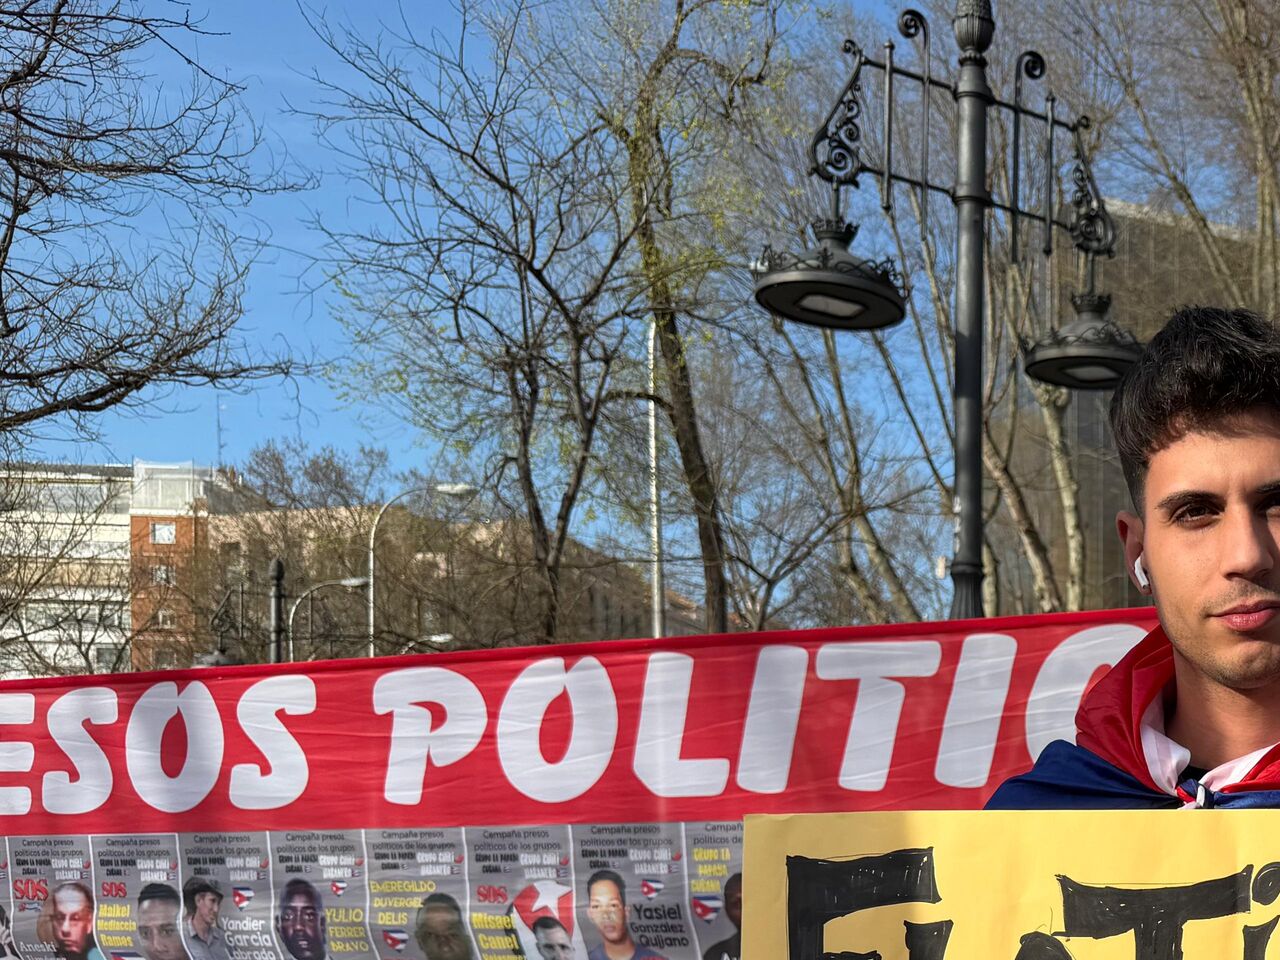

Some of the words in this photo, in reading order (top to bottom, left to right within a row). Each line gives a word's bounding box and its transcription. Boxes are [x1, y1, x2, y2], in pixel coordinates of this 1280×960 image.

[591, 826, 629, 834] Campaña
[13, 879, 49, 900] SOS
[102, 882, 127, 898] SOS
[326, 909, 363, 922] YULIO
[633, 904, 682, 920] Yasiel
[328, 927, 365, 937] FERRER
